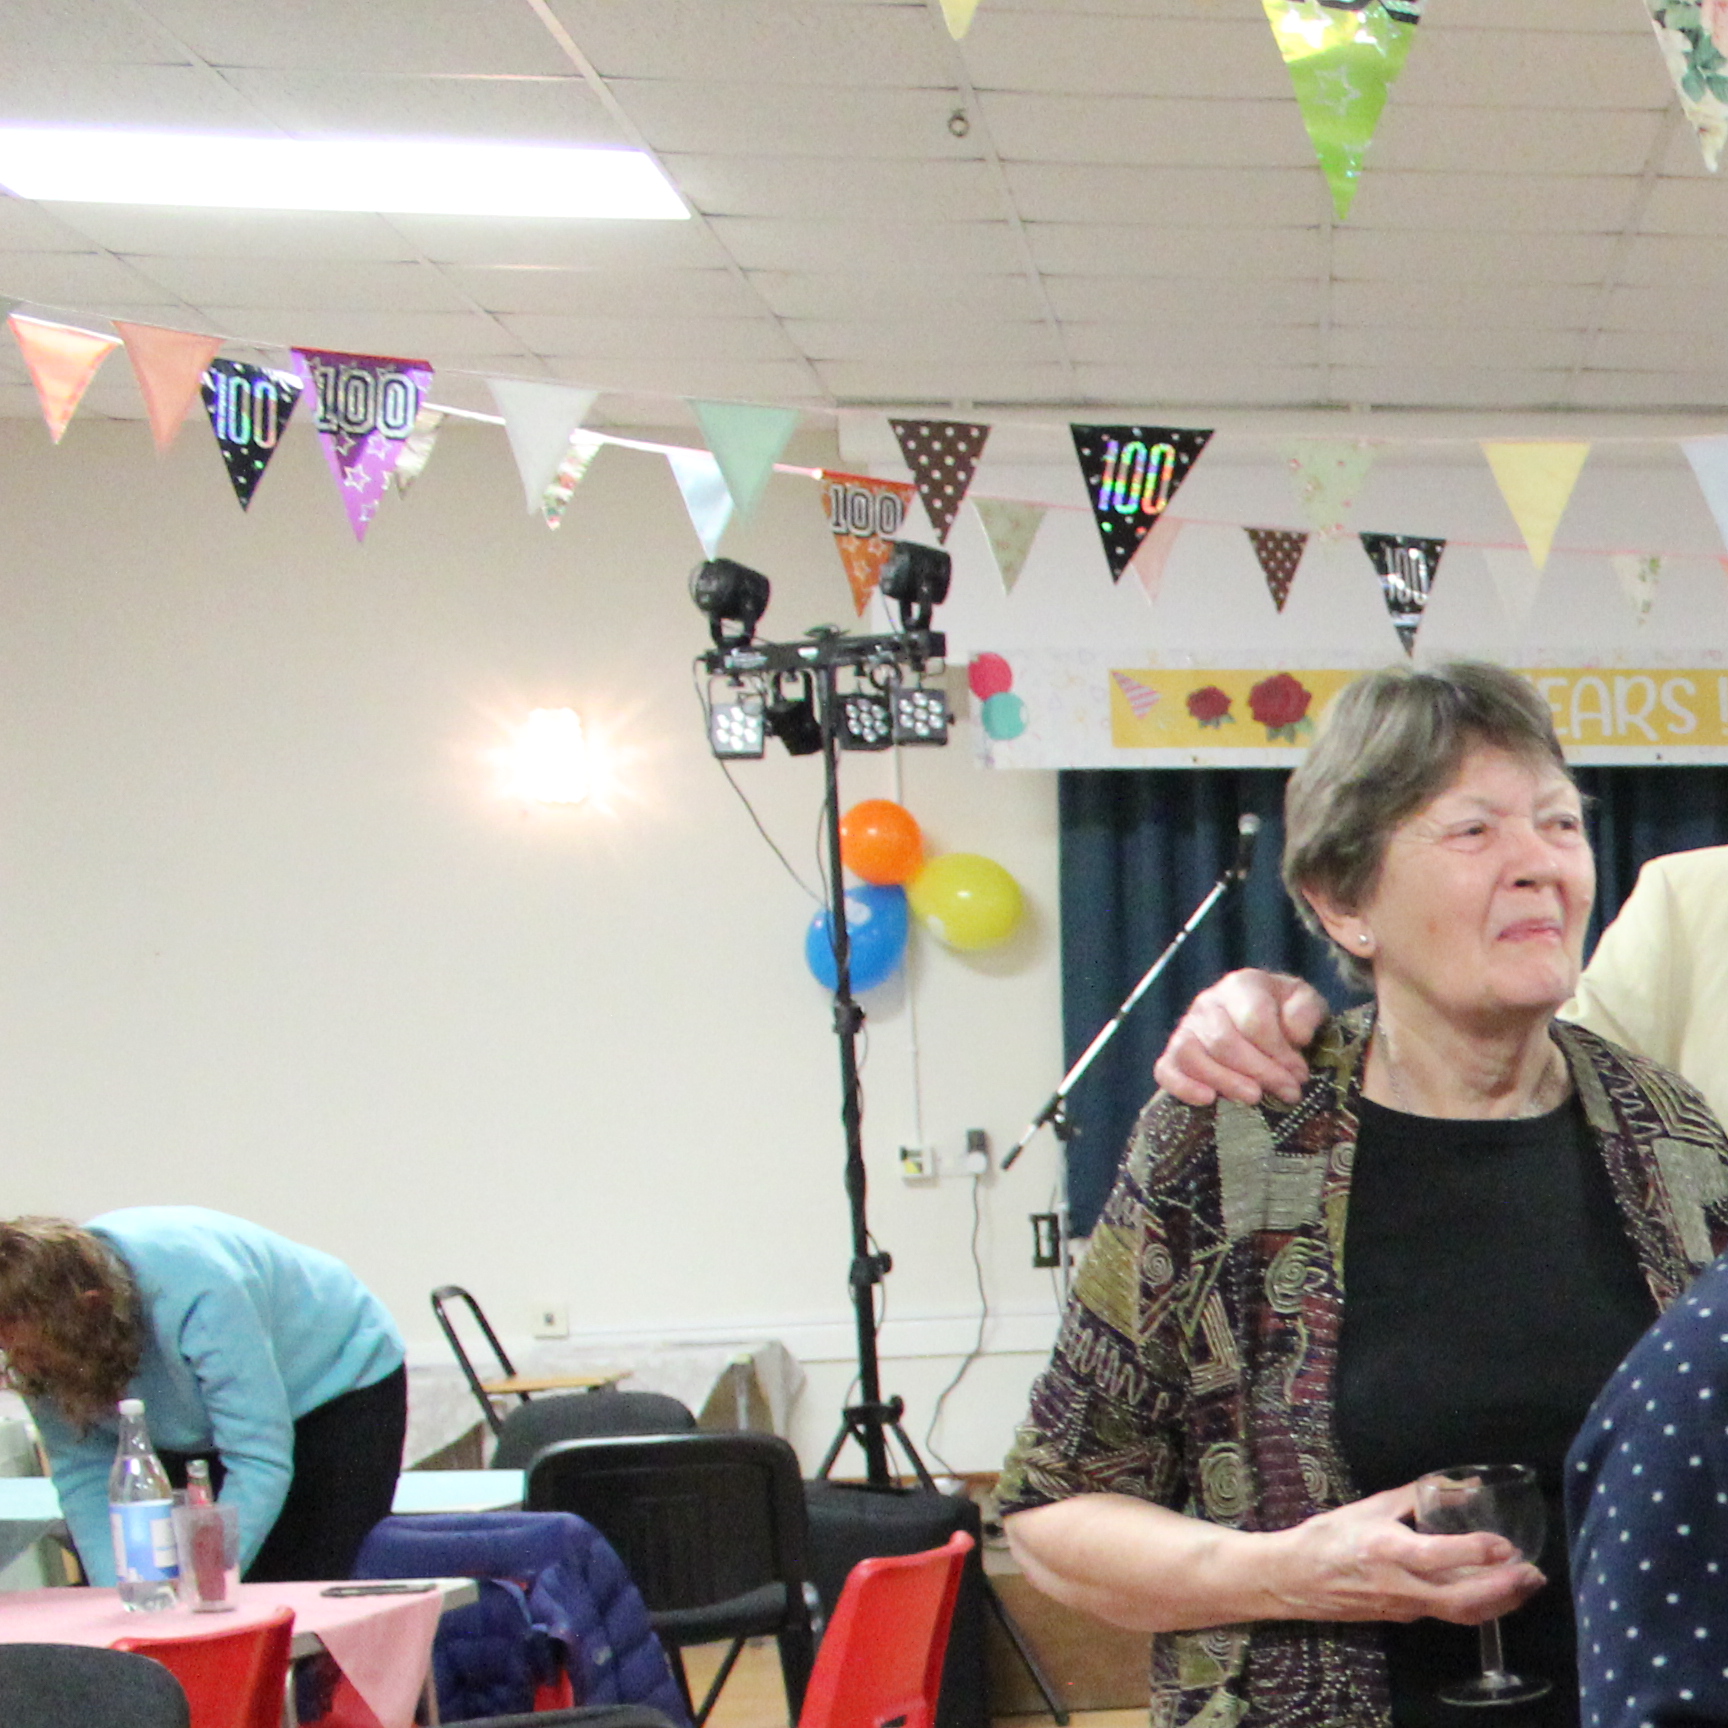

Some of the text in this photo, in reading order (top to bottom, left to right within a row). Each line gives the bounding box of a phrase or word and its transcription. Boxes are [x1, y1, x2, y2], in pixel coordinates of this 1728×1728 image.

[214, 368, 279, 449] 100
[314, 360, 418, 441] 100
[829, 482, 904, 539] 100
[1098, 440, 1177, 514] 100
[1523, 674, 1698, 741] EARS
